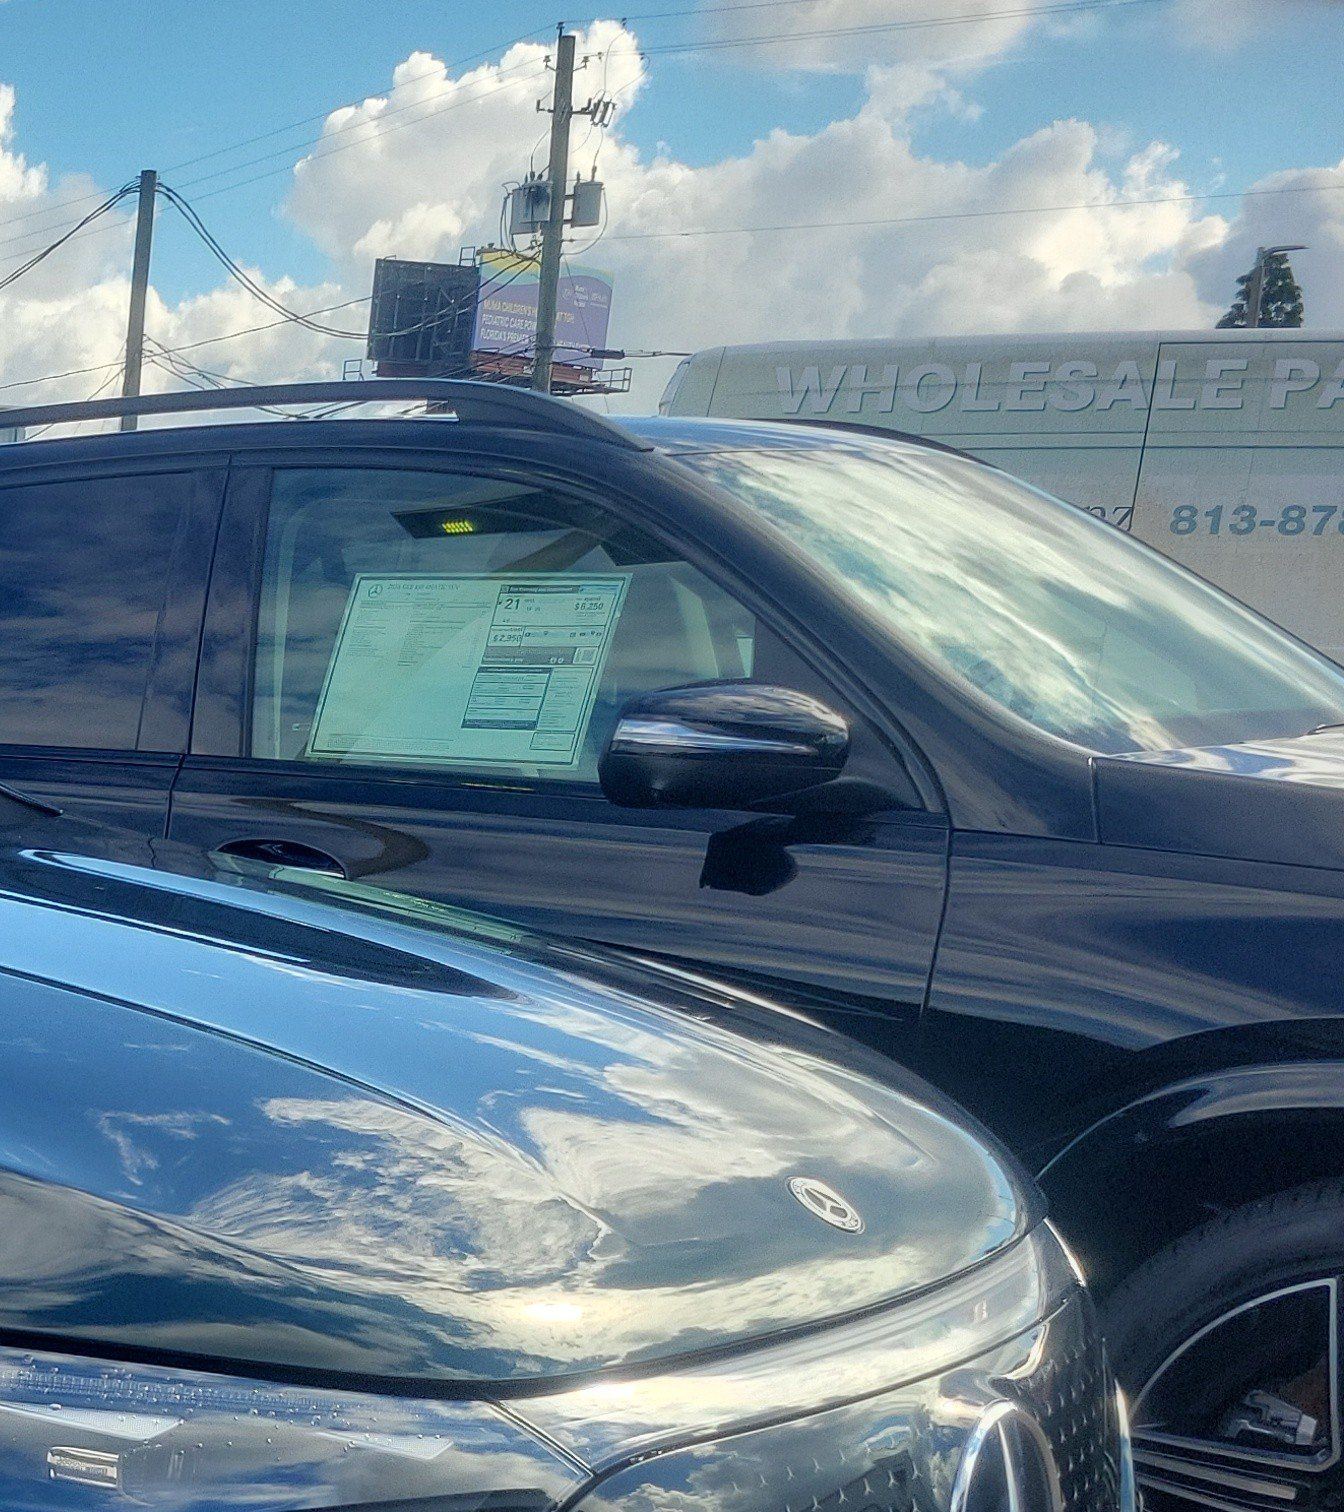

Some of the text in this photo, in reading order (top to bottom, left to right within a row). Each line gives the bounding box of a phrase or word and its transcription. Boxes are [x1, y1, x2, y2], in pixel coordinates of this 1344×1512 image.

[775, 359, 1248, 415] WHOLESALE
[1169, 504, 1344, 536] 813-87
[504, 598, 520, 610] 21
